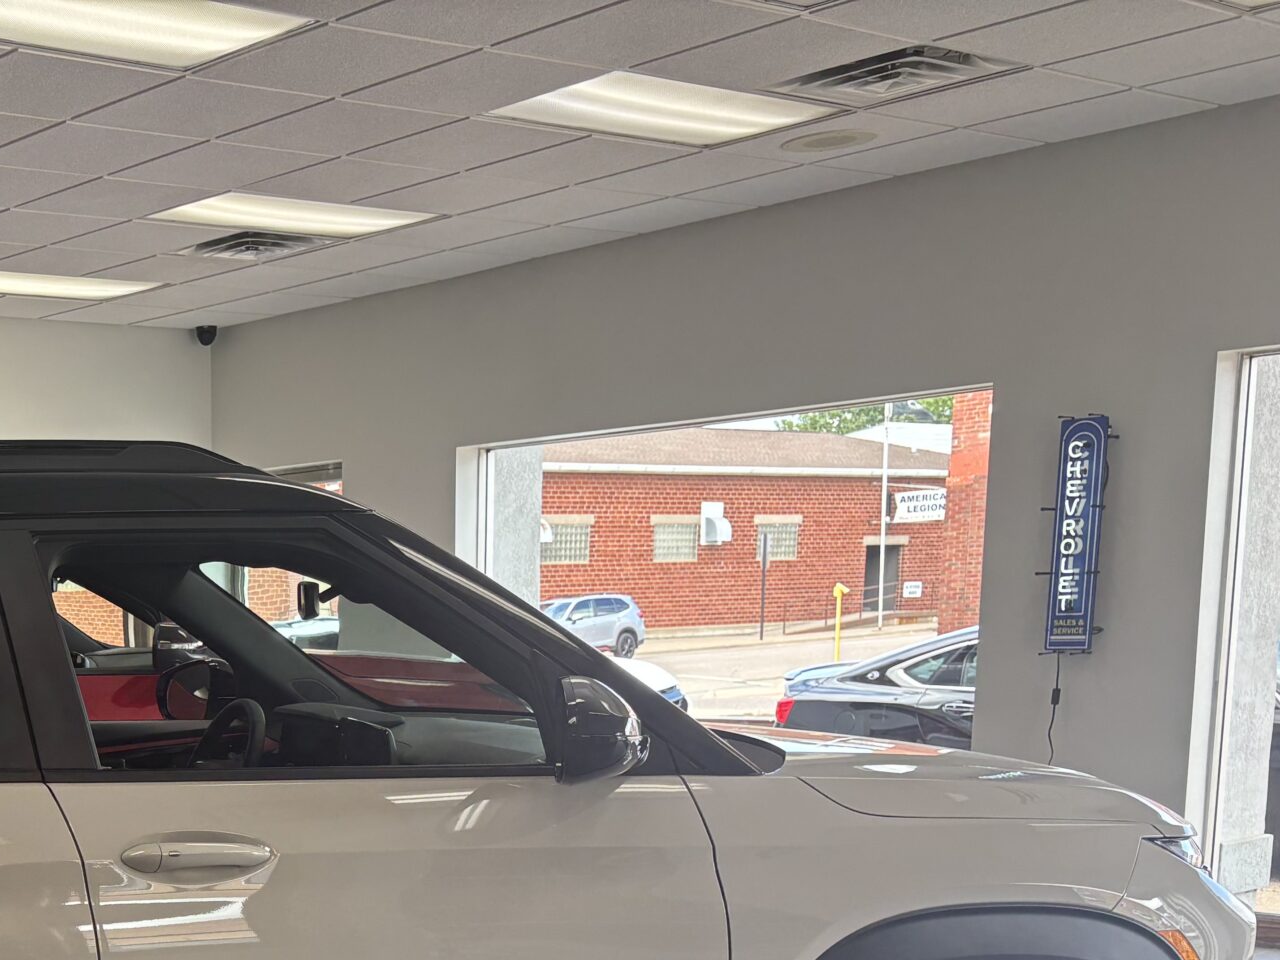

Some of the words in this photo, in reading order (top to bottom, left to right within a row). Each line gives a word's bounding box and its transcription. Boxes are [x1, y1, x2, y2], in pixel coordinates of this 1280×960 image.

[907, 503, 946, 513] LEGION
[1058, 440, 1087, 612] CHEVROLET
[1053, 619, 1076, 627] SALES
[1052, 627, 1084, 635] SERVICE
